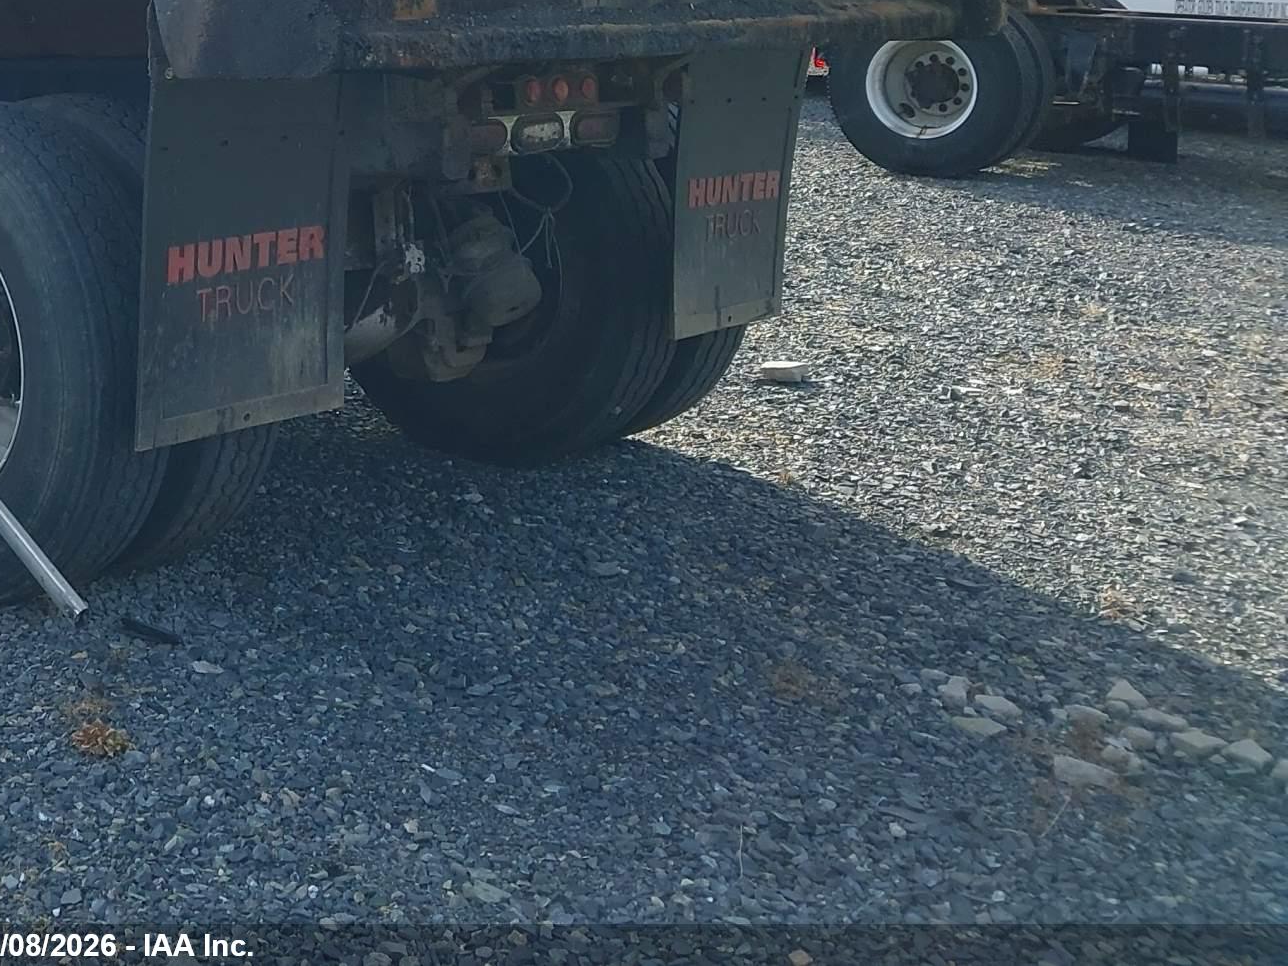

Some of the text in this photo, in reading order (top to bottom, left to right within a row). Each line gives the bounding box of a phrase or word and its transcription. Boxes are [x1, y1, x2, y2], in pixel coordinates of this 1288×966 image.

[688, 170, 780, 208] HUNTER
[704, 209, 761, 242] TRUCK
[167, 225, 325, 284] HUNTER
[196, 273, 294, 323] TRUCK
